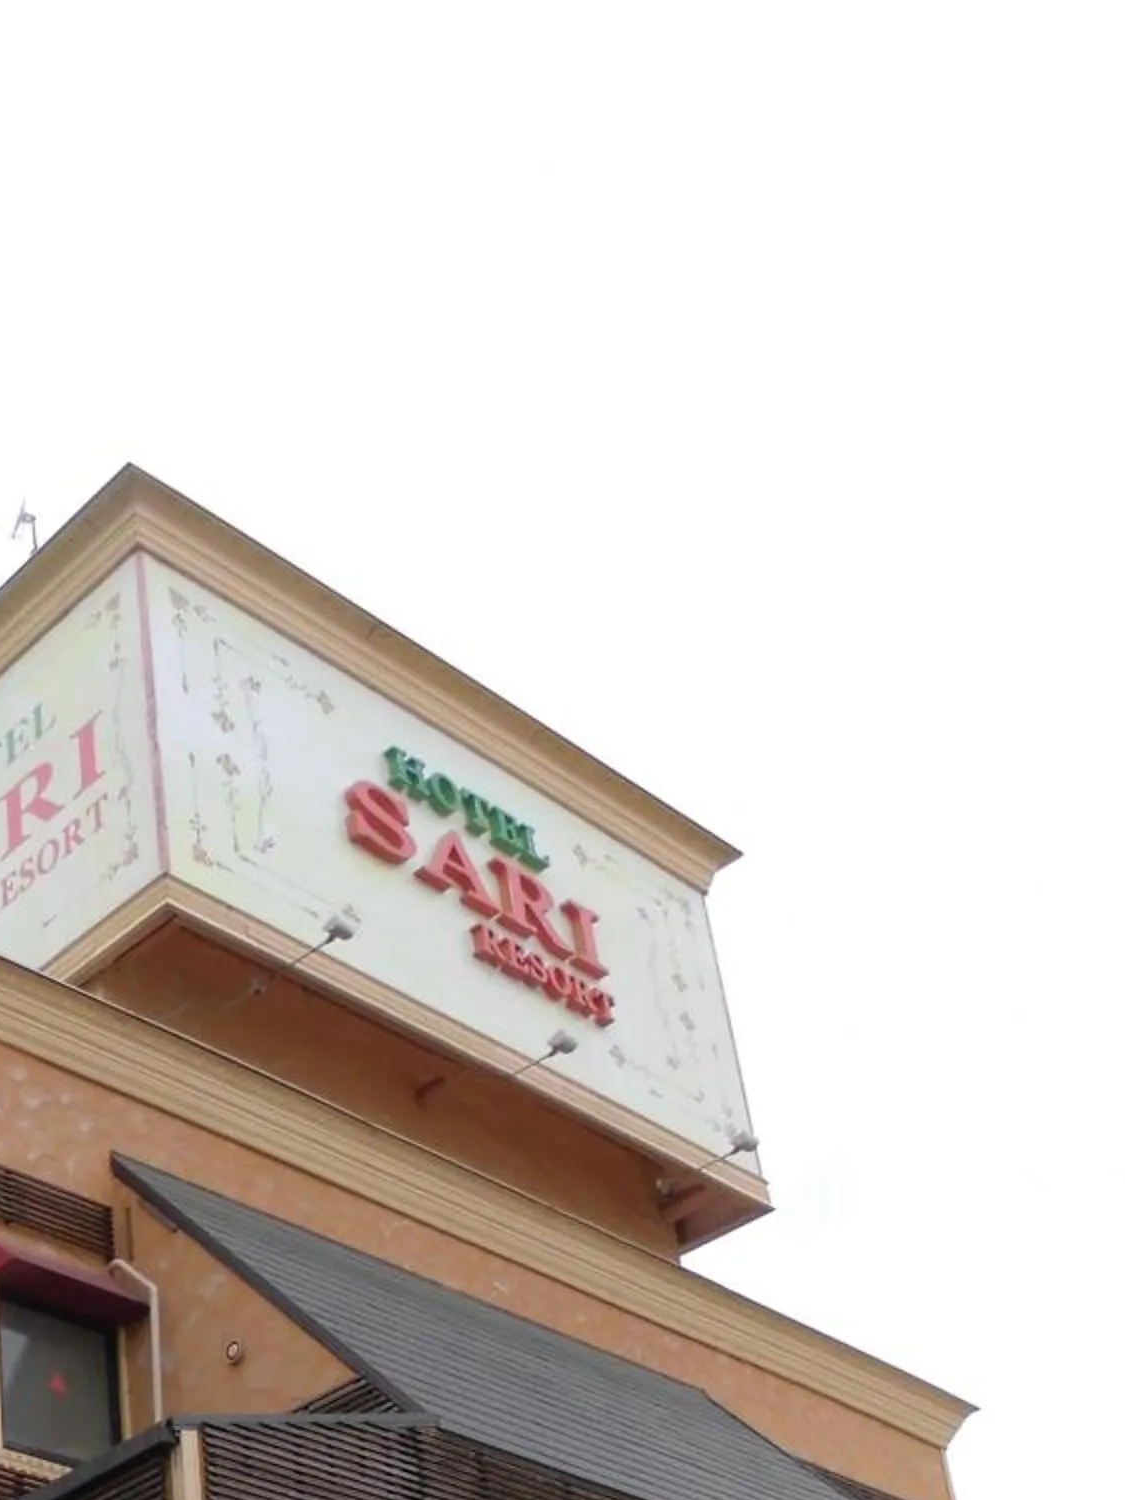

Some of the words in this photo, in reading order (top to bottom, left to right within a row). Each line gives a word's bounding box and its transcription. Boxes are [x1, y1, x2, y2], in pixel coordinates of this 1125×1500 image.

[383, 746, 550, 873] HOTEL
[344, 780, 608, 980] SARI
[470, 923, 615, 1028] RESORT
